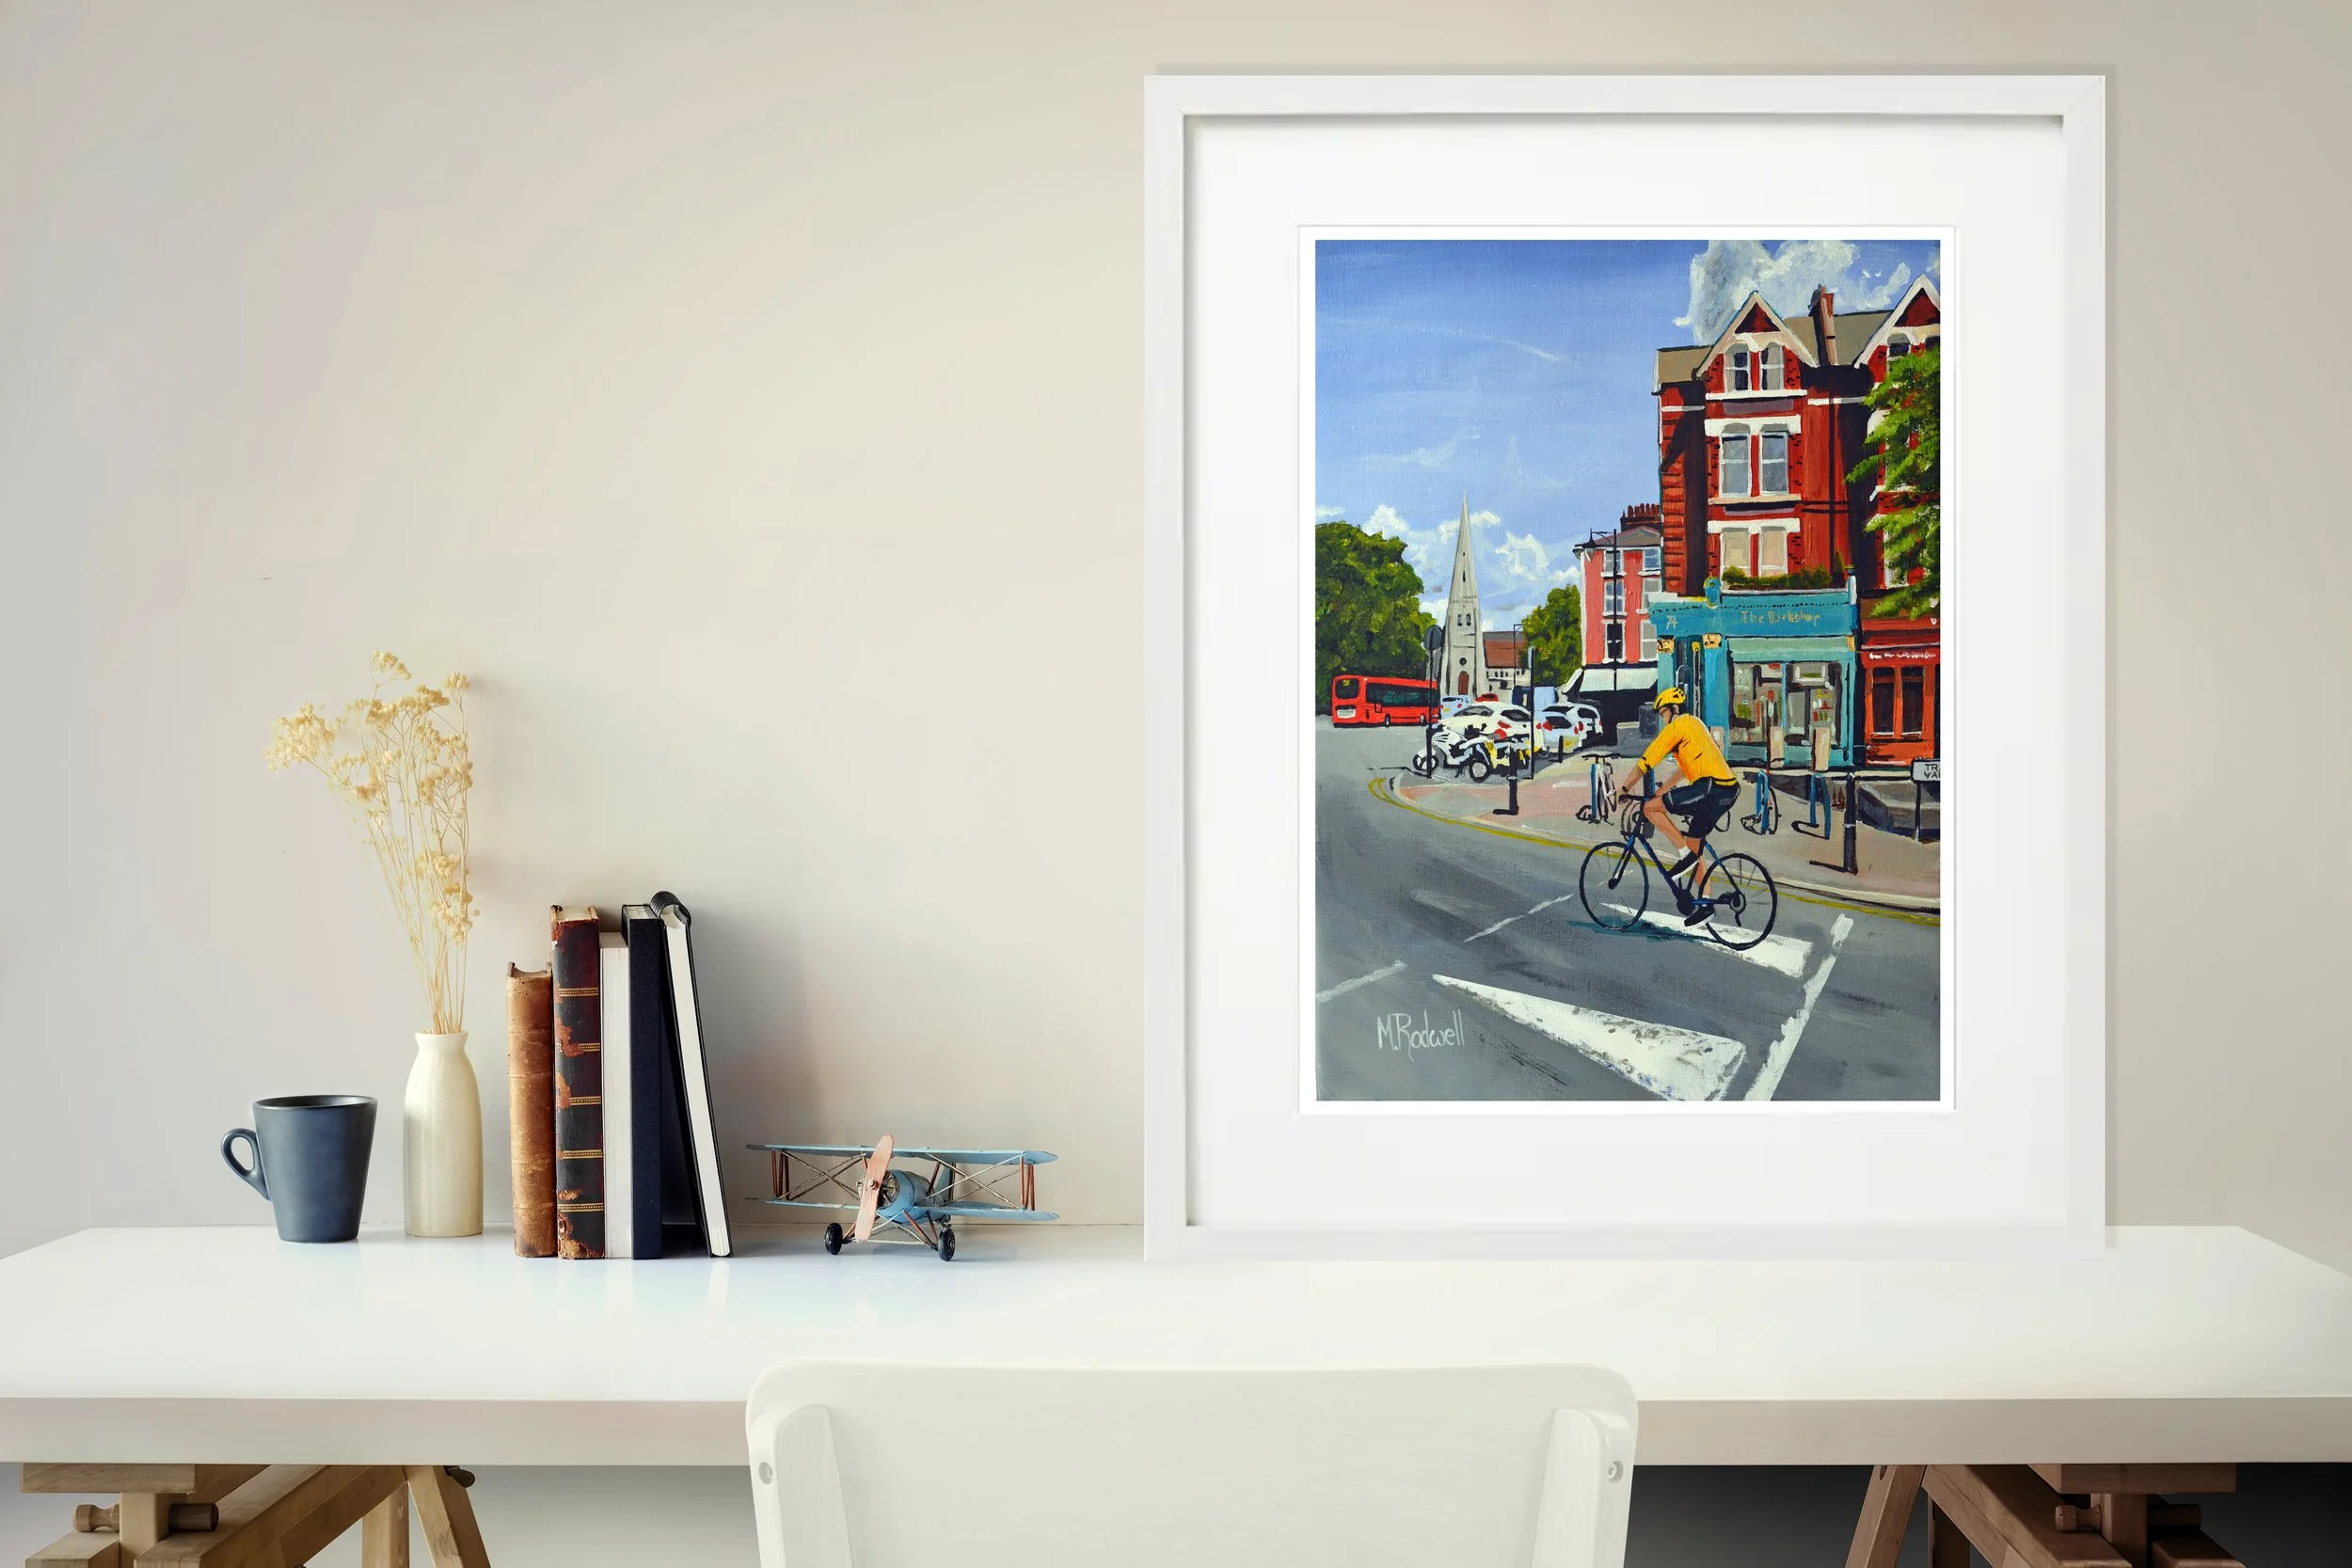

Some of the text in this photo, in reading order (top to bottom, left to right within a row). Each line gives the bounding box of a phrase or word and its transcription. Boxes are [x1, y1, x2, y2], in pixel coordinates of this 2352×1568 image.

[1740, 610, 1765, 624] The
[1925, 763, 1940, 772] TR
[1924, 770, 1940, 780] VA
